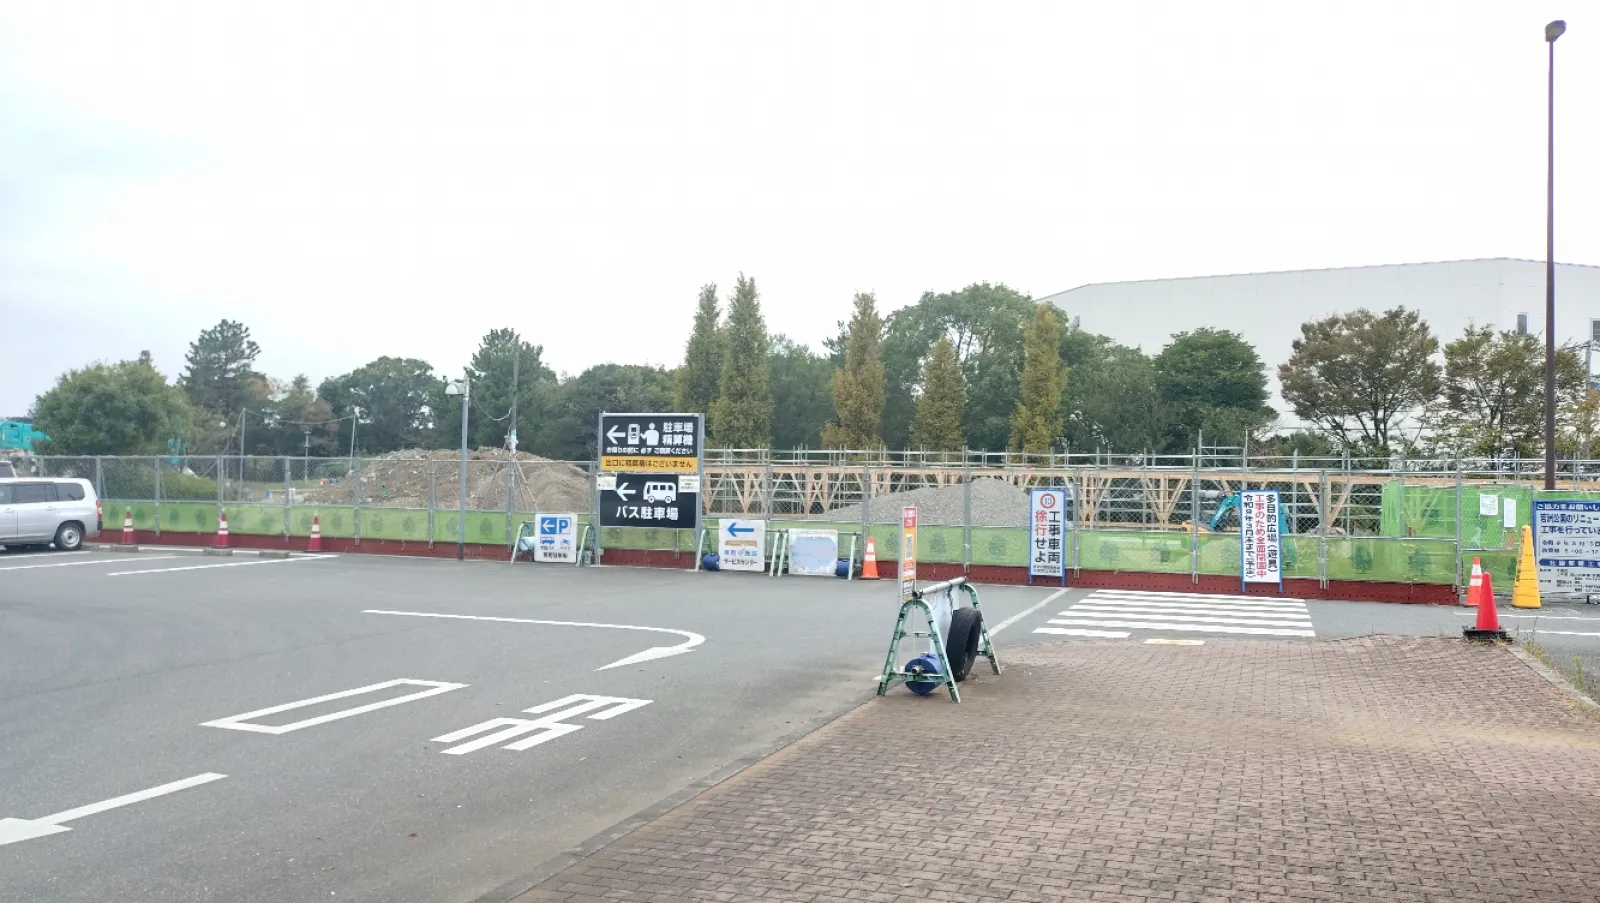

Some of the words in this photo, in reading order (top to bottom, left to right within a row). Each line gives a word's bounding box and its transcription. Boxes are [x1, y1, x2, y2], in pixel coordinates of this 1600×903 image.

[663, 421, 693, 433] 駐車場
[662, 434, 694, 446] 精算機
[616, 506, 679, 520] バス駐車場
[559, 519, 568, 533] P
[1035, 509, 1048, 564] 徐行せよ
[1048, 510, 1060, 564] 工事車両
[1255, 495, 1266, 577] 工事のため全面閉園中
